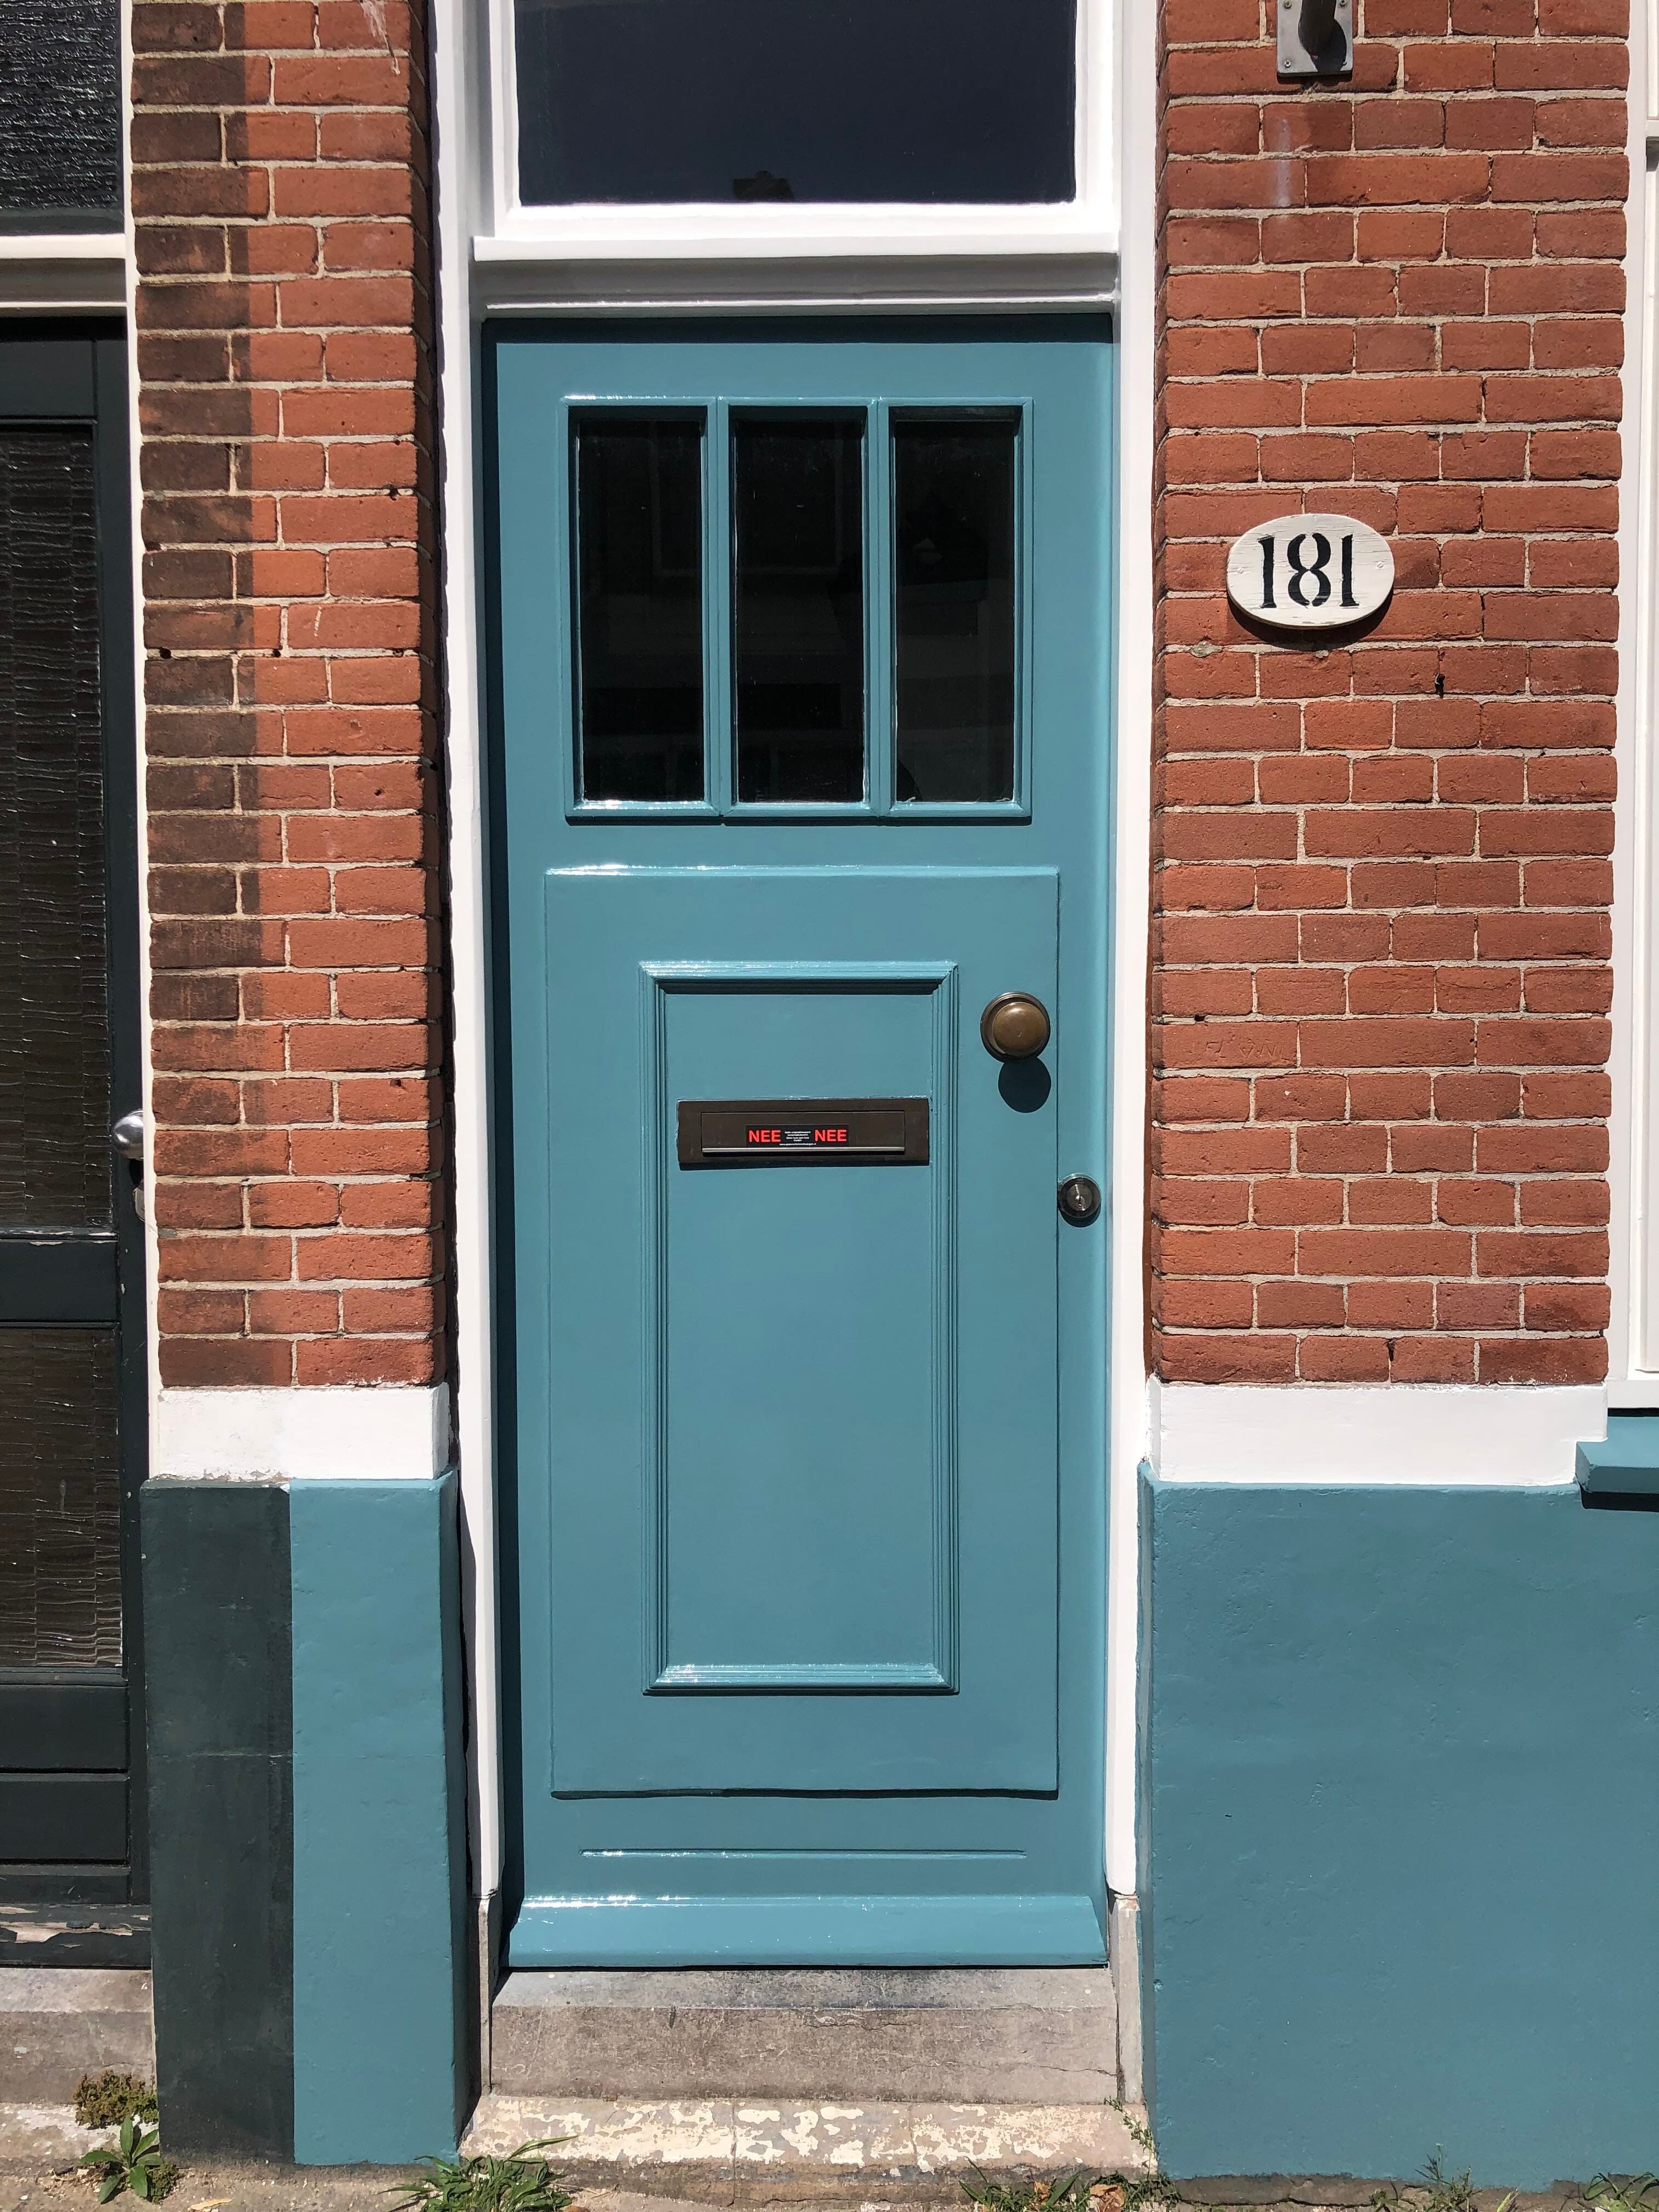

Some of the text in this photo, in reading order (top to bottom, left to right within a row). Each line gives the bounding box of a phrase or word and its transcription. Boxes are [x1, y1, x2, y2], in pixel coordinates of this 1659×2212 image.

[1257, 533, 1359, 608] 181
[749, 1129, 847, 1142] NEE NEE
